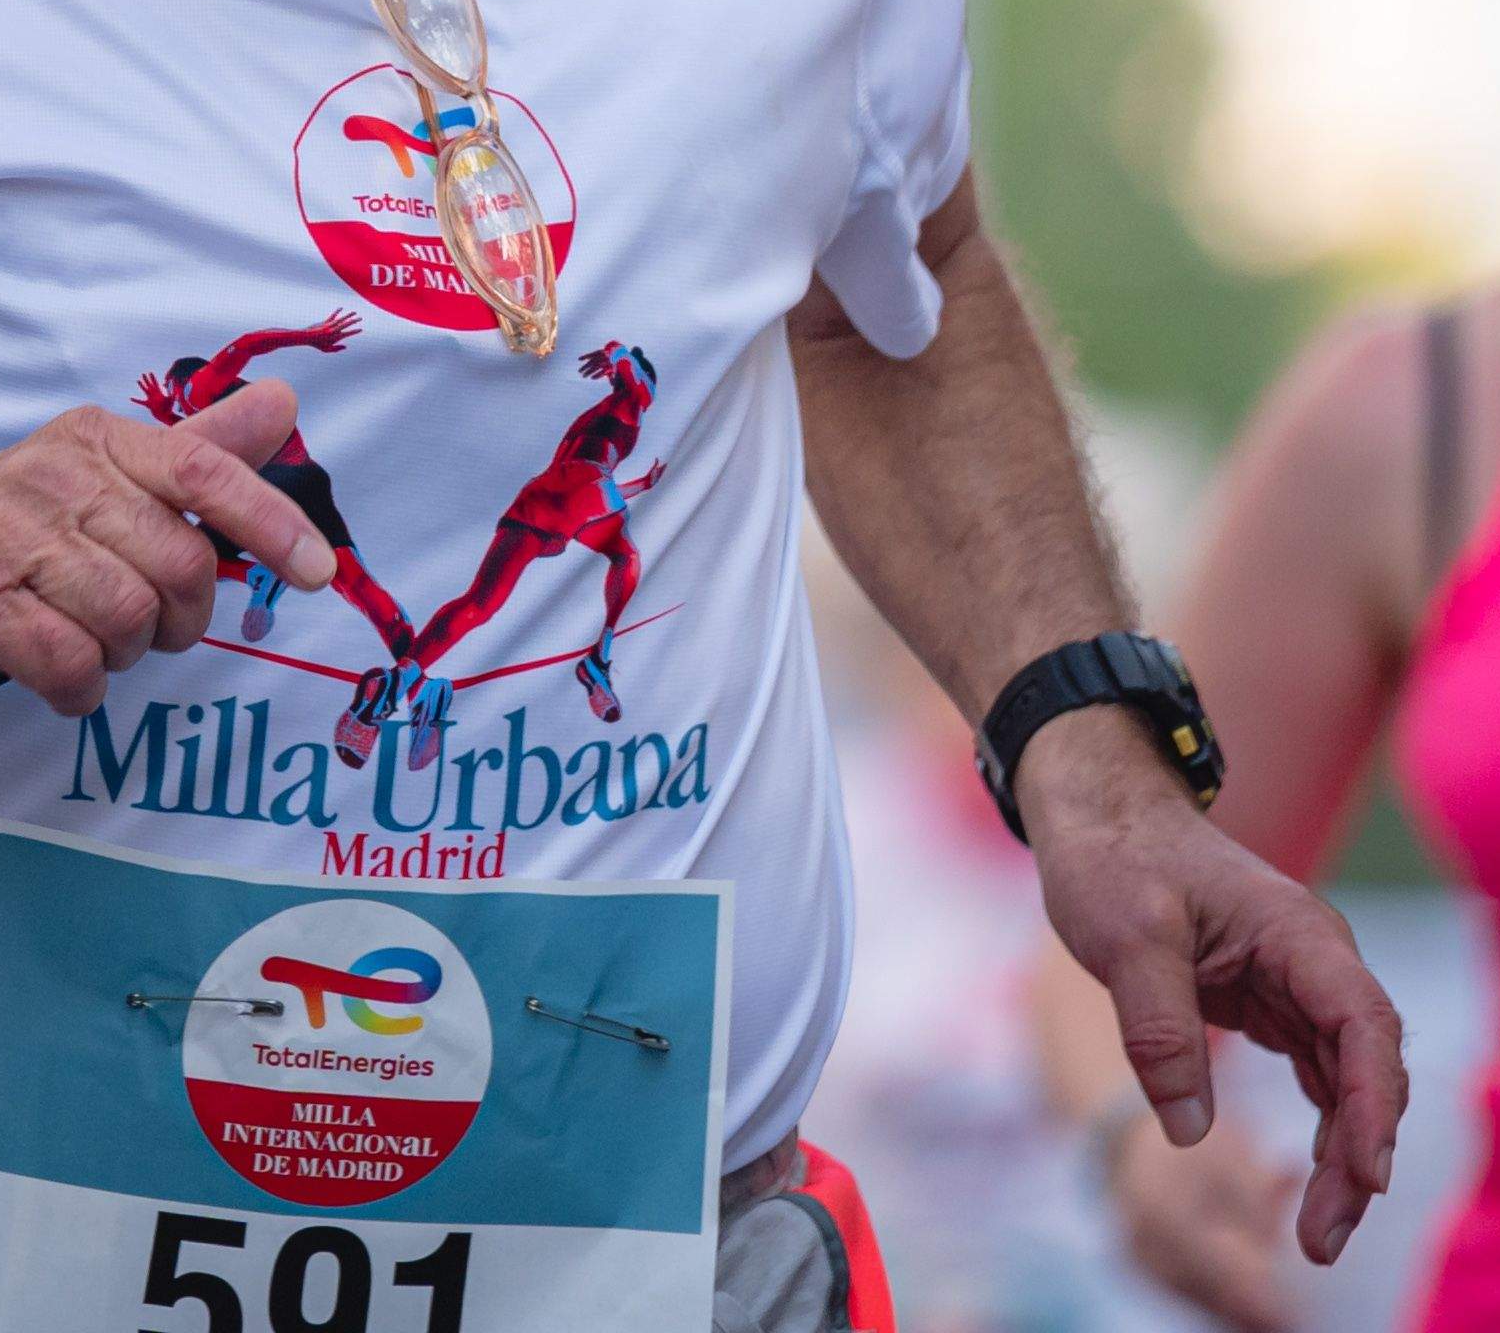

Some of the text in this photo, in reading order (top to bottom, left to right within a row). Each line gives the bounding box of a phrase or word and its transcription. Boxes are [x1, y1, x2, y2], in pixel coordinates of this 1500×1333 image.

[370, 263, 417, 288] DE
[60, 695, 713, 834] Milla Urbana
[320, 830, 506, 881] Madrid
[252, 1043, 435, 1081] TotalEnergies
[291, 1102, 377, 1128] MILLA
[253, 1152, 404, 1183] DE MADRID
[138, 1210, 474, 1333] 591
